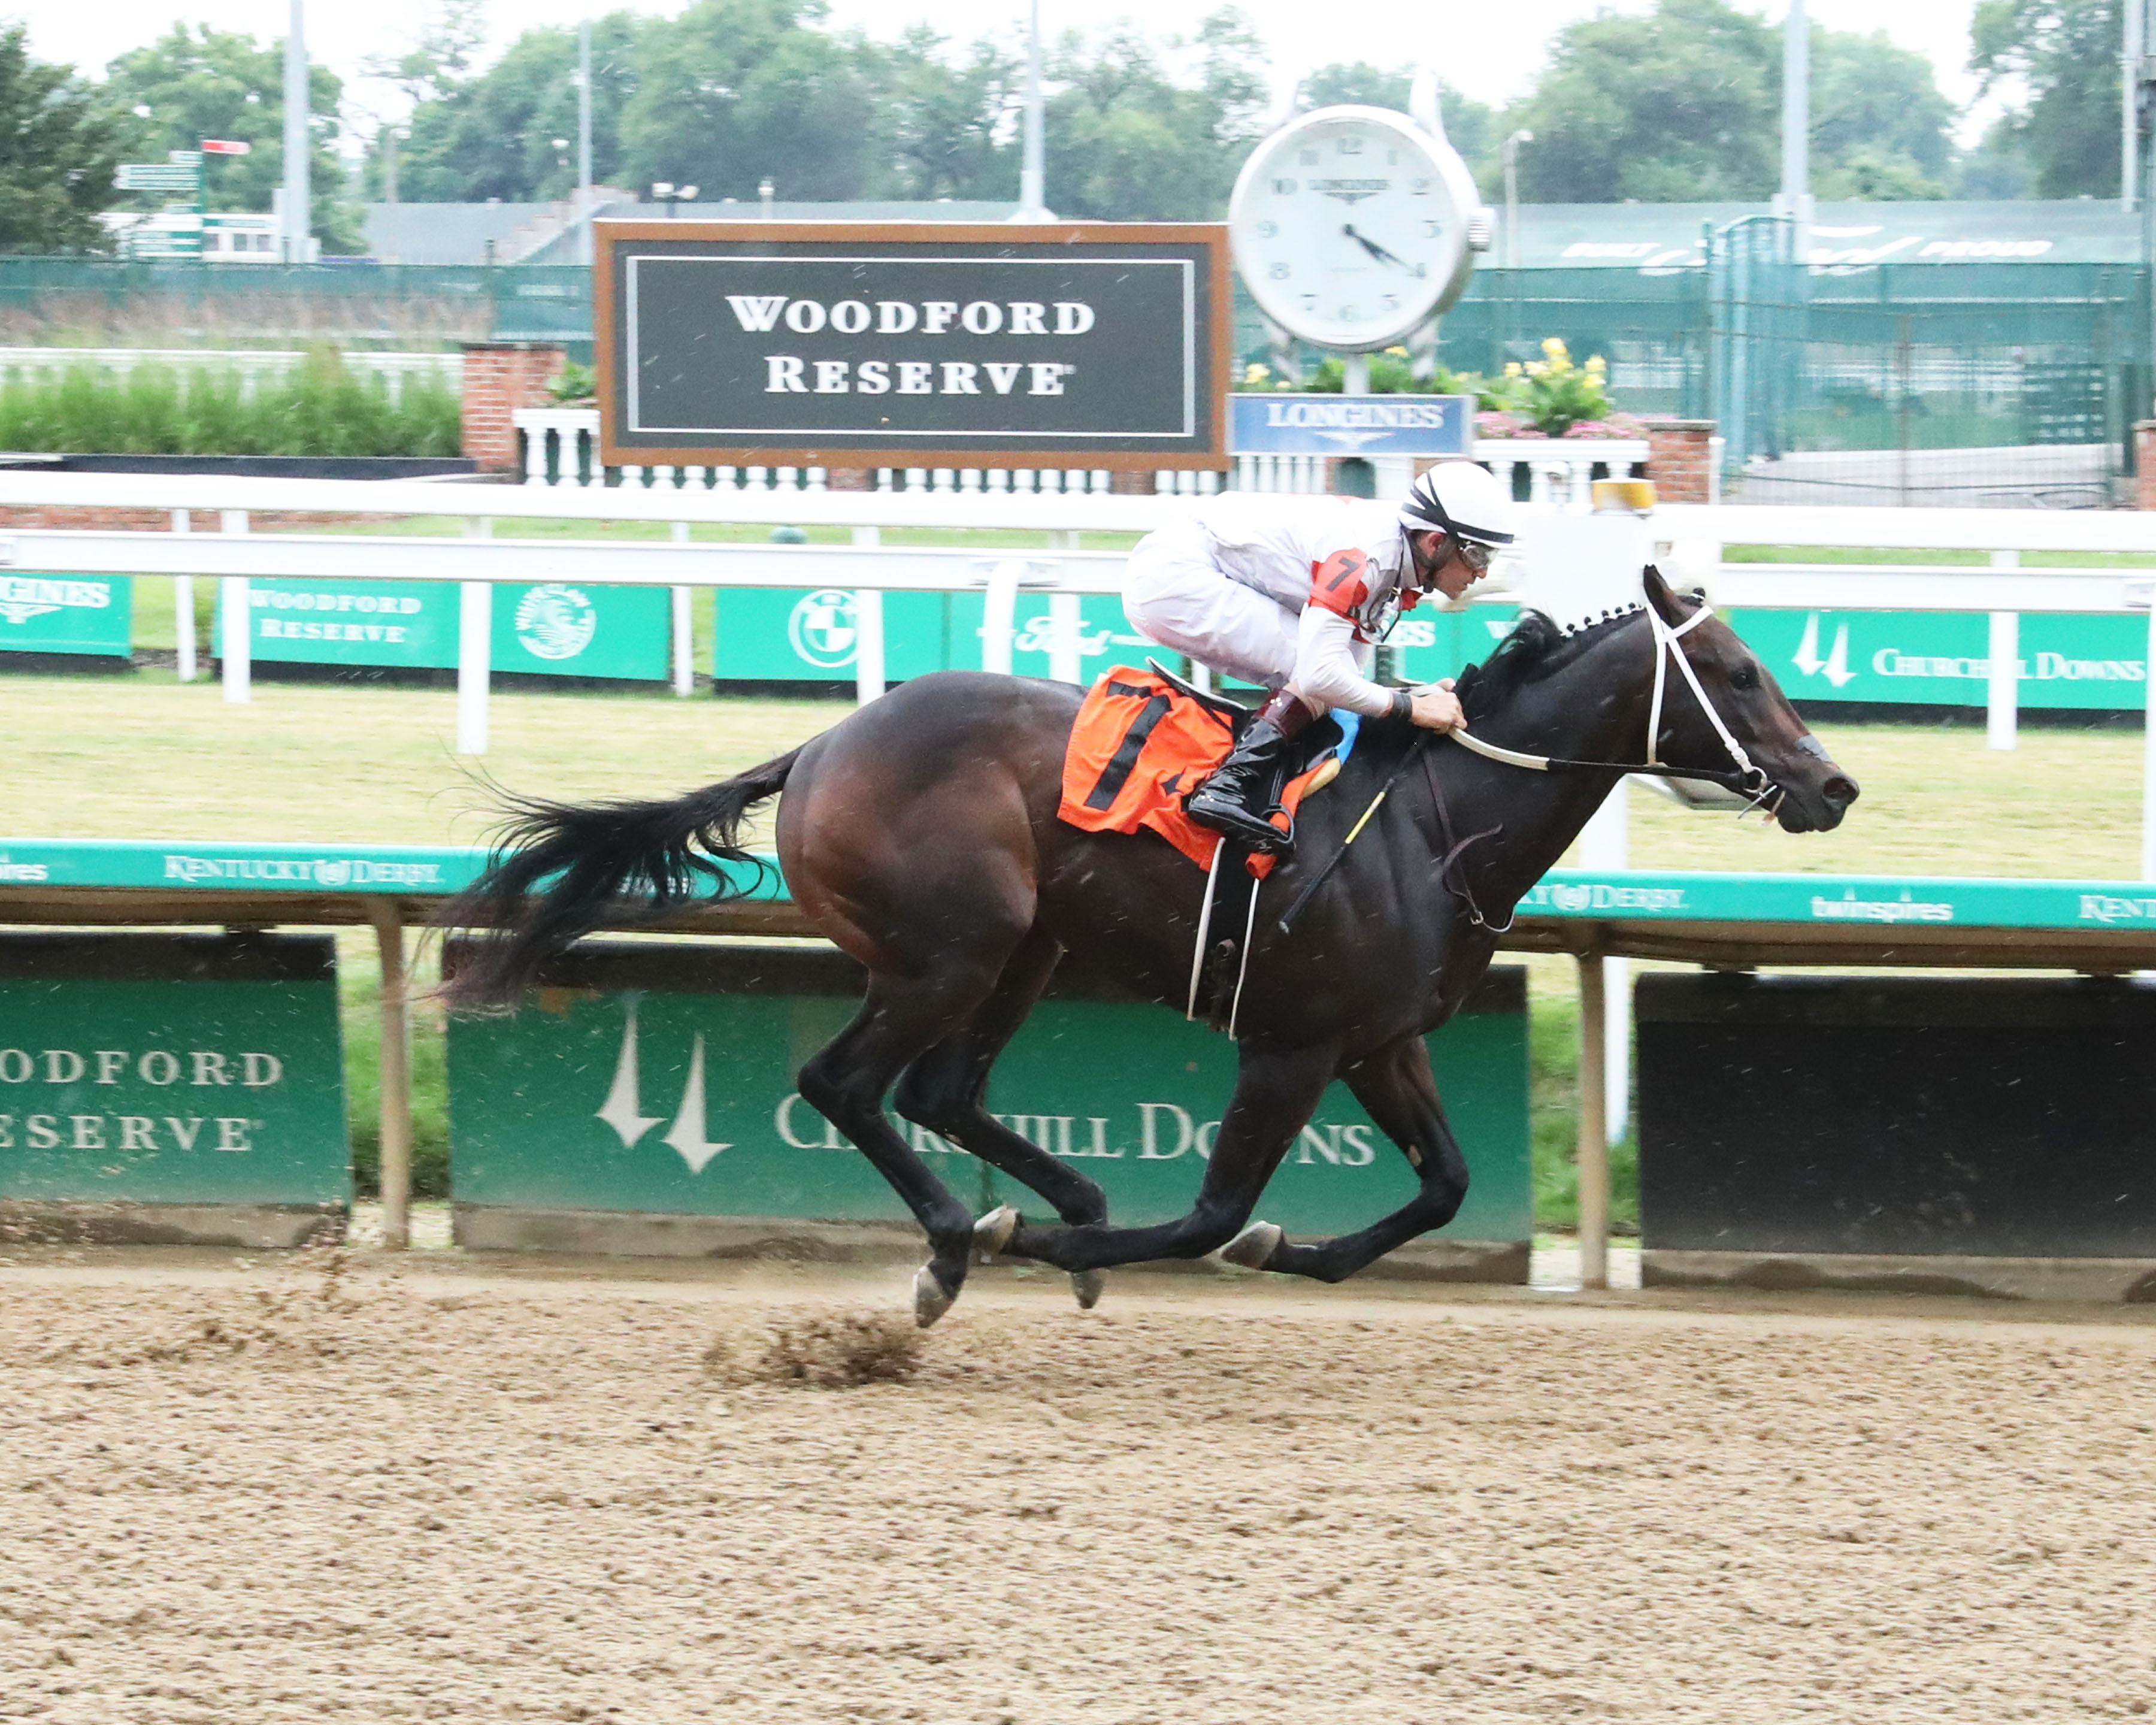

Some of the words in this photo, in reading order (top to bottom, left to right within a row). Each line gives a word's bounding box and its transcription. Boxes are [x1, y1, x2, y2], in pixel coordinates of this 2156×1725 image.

[725, 295, 1095, 334] WOODFORD
[764, 356, 1065, 395] RESERVE
[1267, 403, 1444, 428] LONGINES
[1327, 557, 1359, 591] 7
[246, 589, 422, 614] WOODFORD
[259, 618, 406, 643] RESERVE
[2035, 652, 2146, 681] DOWNS
[163, 855, 315, 882] KENTUCKY
[351, 860, 442, 886] DERBY
[1590, 884, 1685, 912] DERBY
